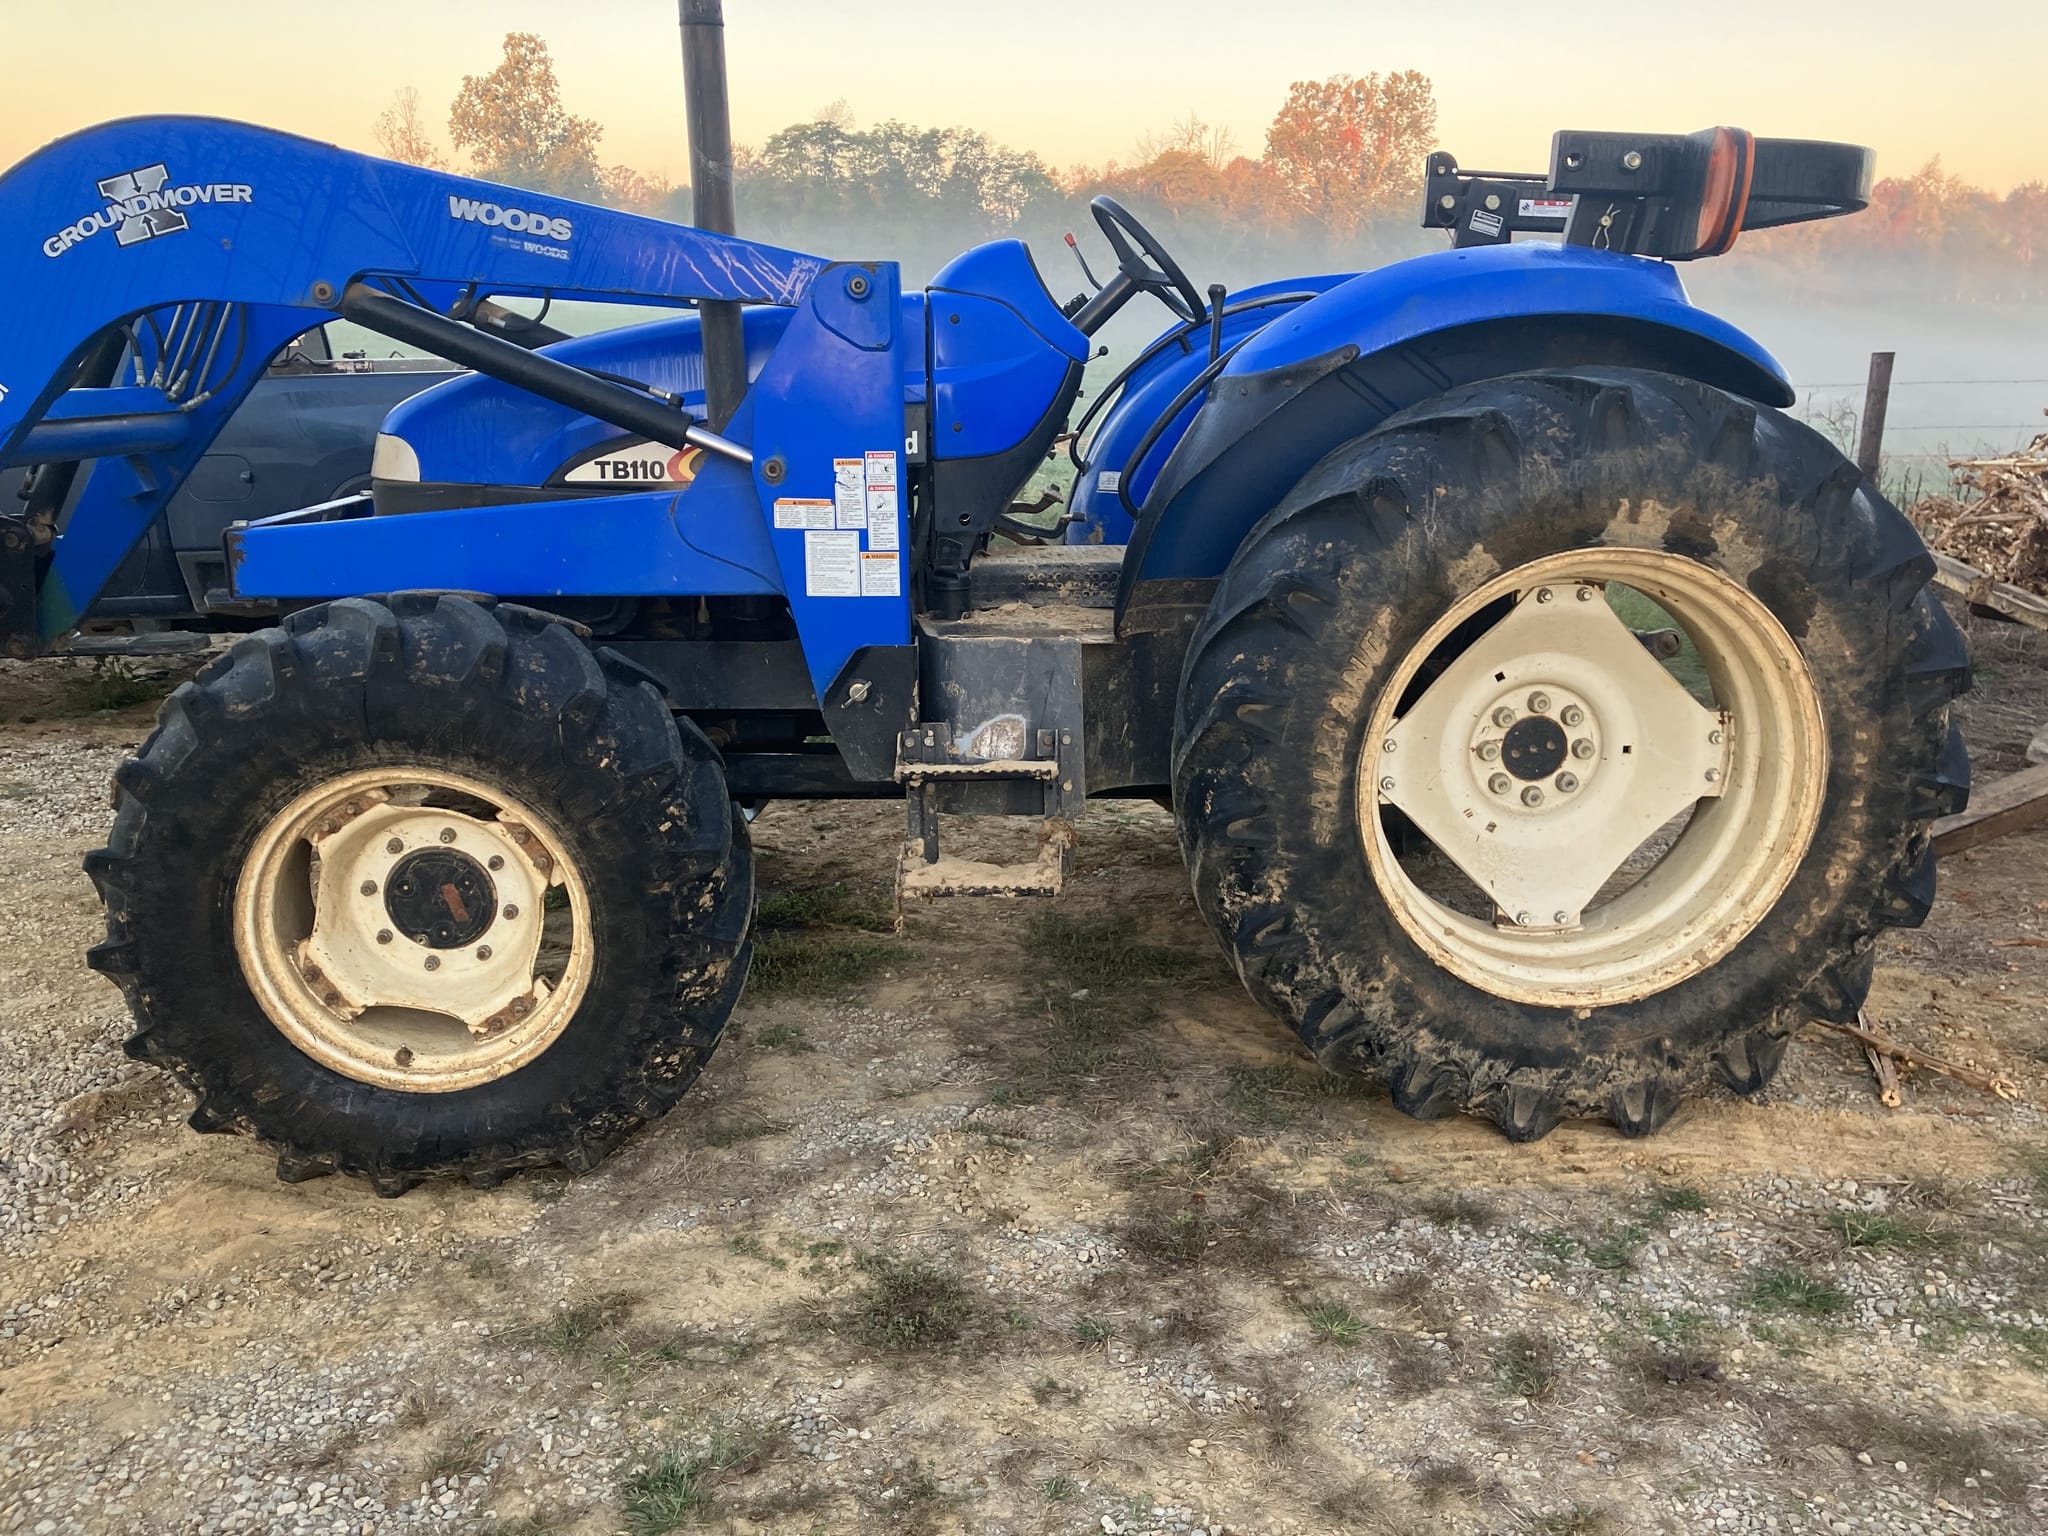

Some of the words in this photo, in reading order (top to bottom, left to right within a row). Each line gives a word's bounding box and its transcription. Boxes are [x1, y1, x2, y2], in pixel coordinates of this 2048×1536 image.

[43, 184, 252, 258] GROUNDMOVER
[449, 195, 573, 241] WOODS
[523, 241, 570, 260] WOODS
[594, 460, 666, 480] TB110
